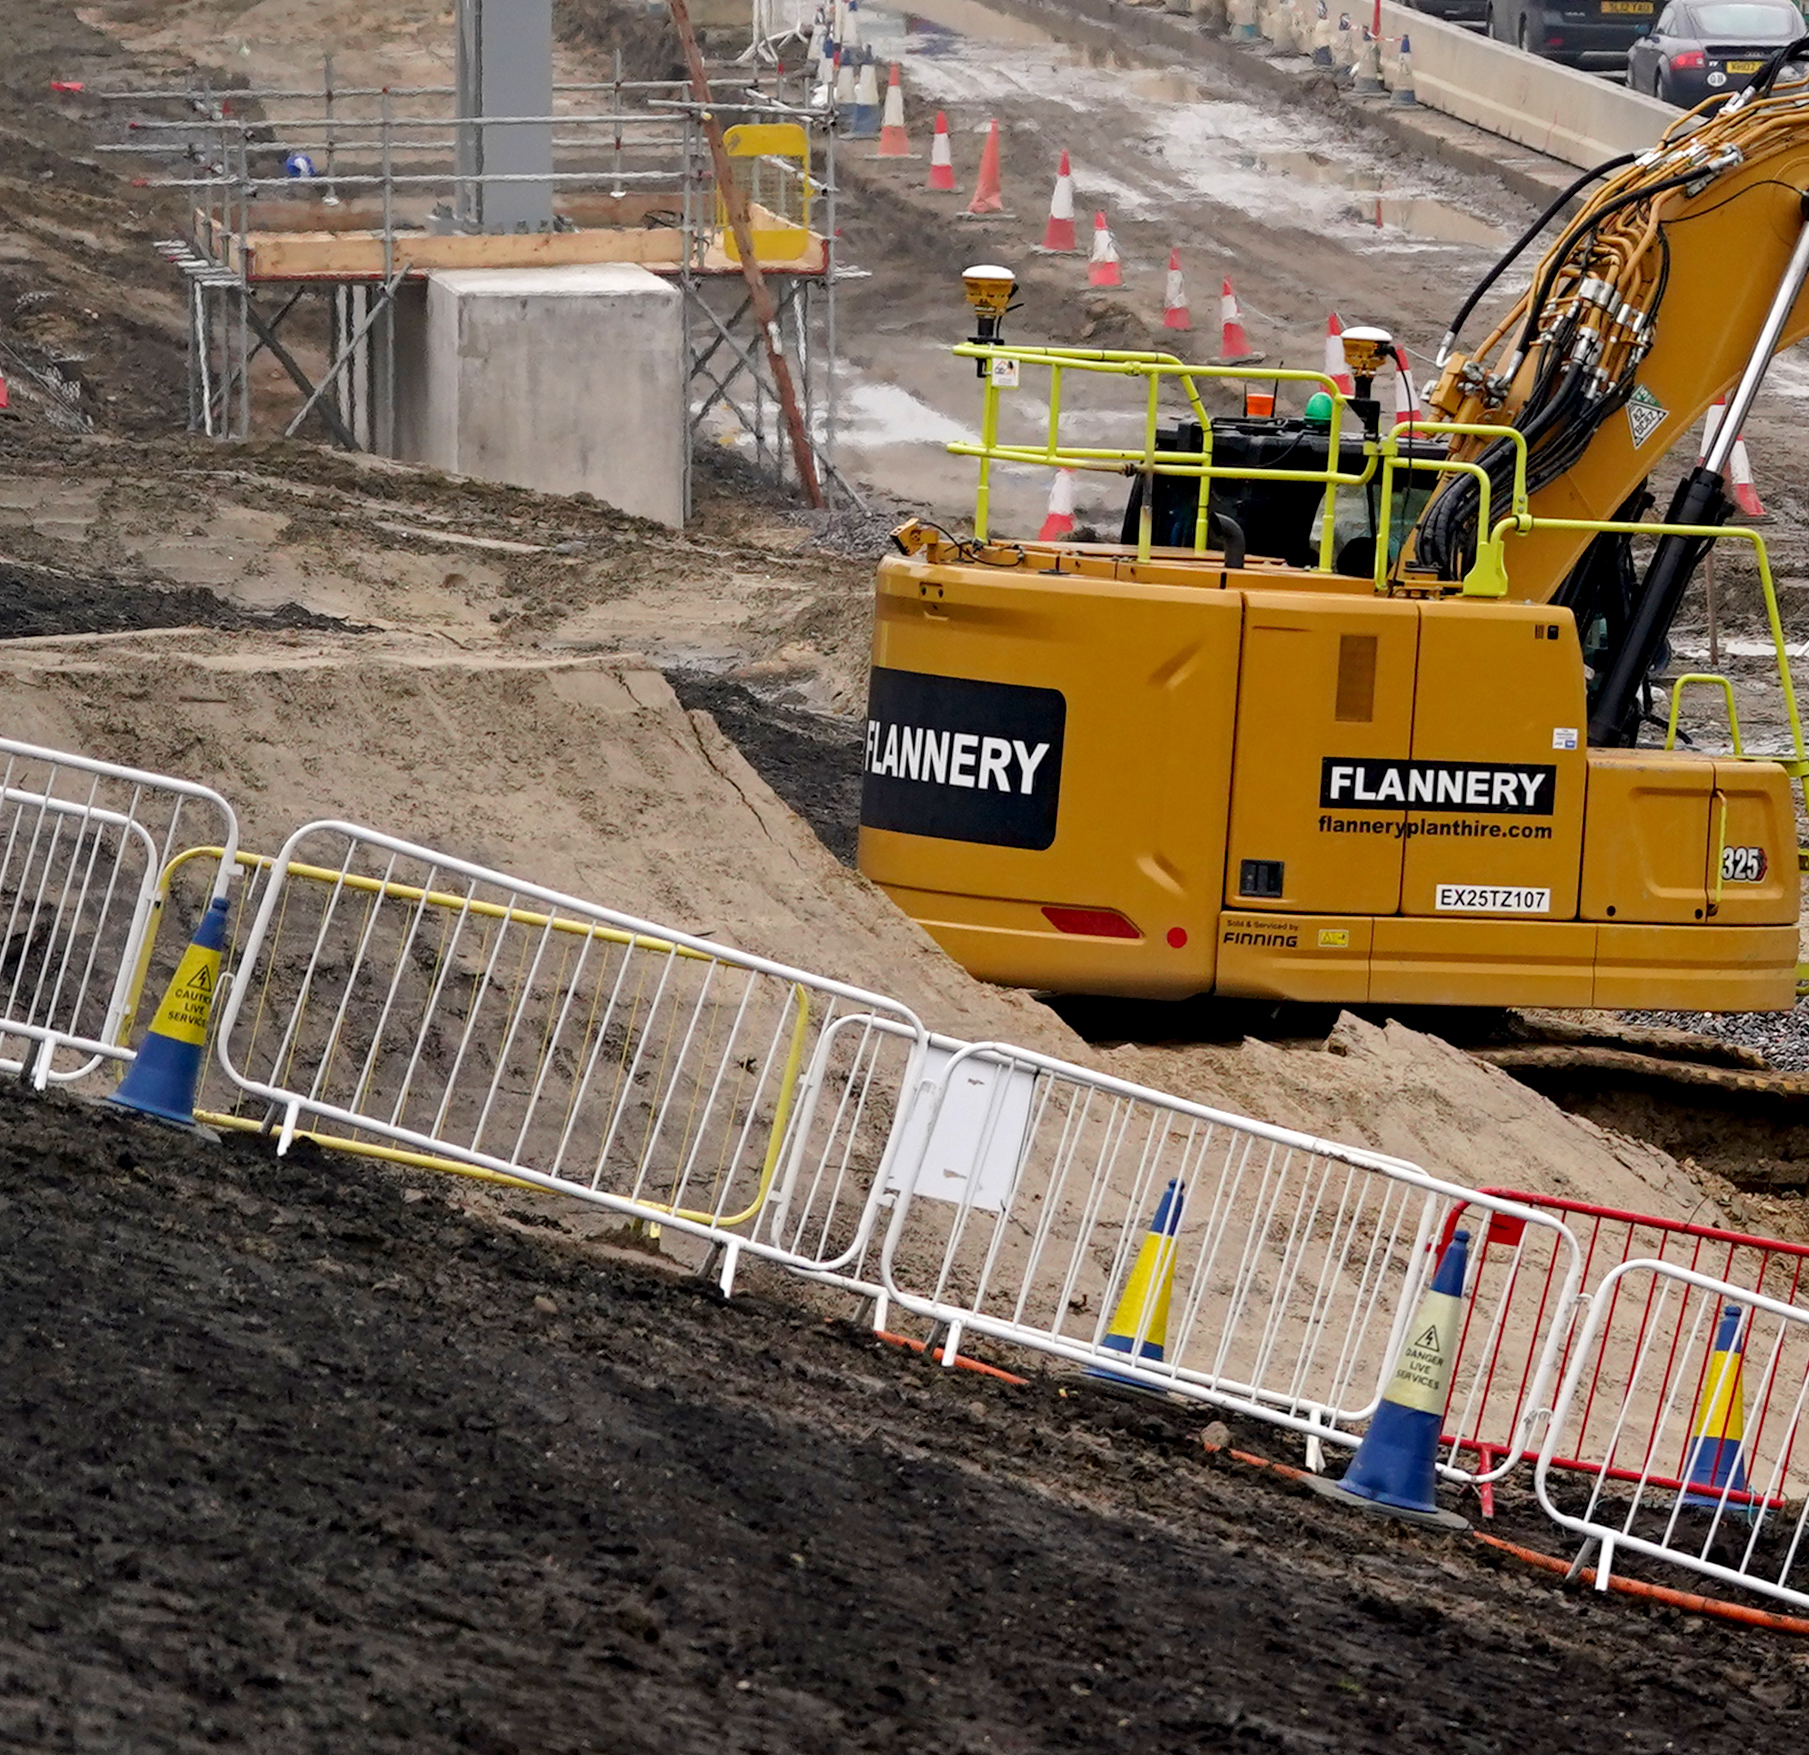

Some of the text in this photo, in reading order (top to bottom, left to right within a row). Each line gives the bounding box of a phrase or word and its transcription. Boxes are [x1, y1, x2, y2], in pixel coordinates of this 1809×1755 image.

[864, 719, 1050, 795] FLANNERY
[1329, 765, 1546, 807] FLANNERY
[1318, 815, 1553, 840] flanneryplanthire.com
[1721, 846, 1760, 880] 325
[1440, 888, 1546, 909] EX25TZ107
[1227, 920, 1245, 928] Sold
[1254, 921, 1287, 931] Serviced
[1288, 923, 1299, 932] by
[1223, 932, 1299, 948] FINNING
[184, 1003, 205, 1016] LIVE
[1405, 1347, 1444, 1367] DANGER
[1409, 1360, 1431, 1375] LIVE
[1396, 1368, 1440, 1390] SERVICES
